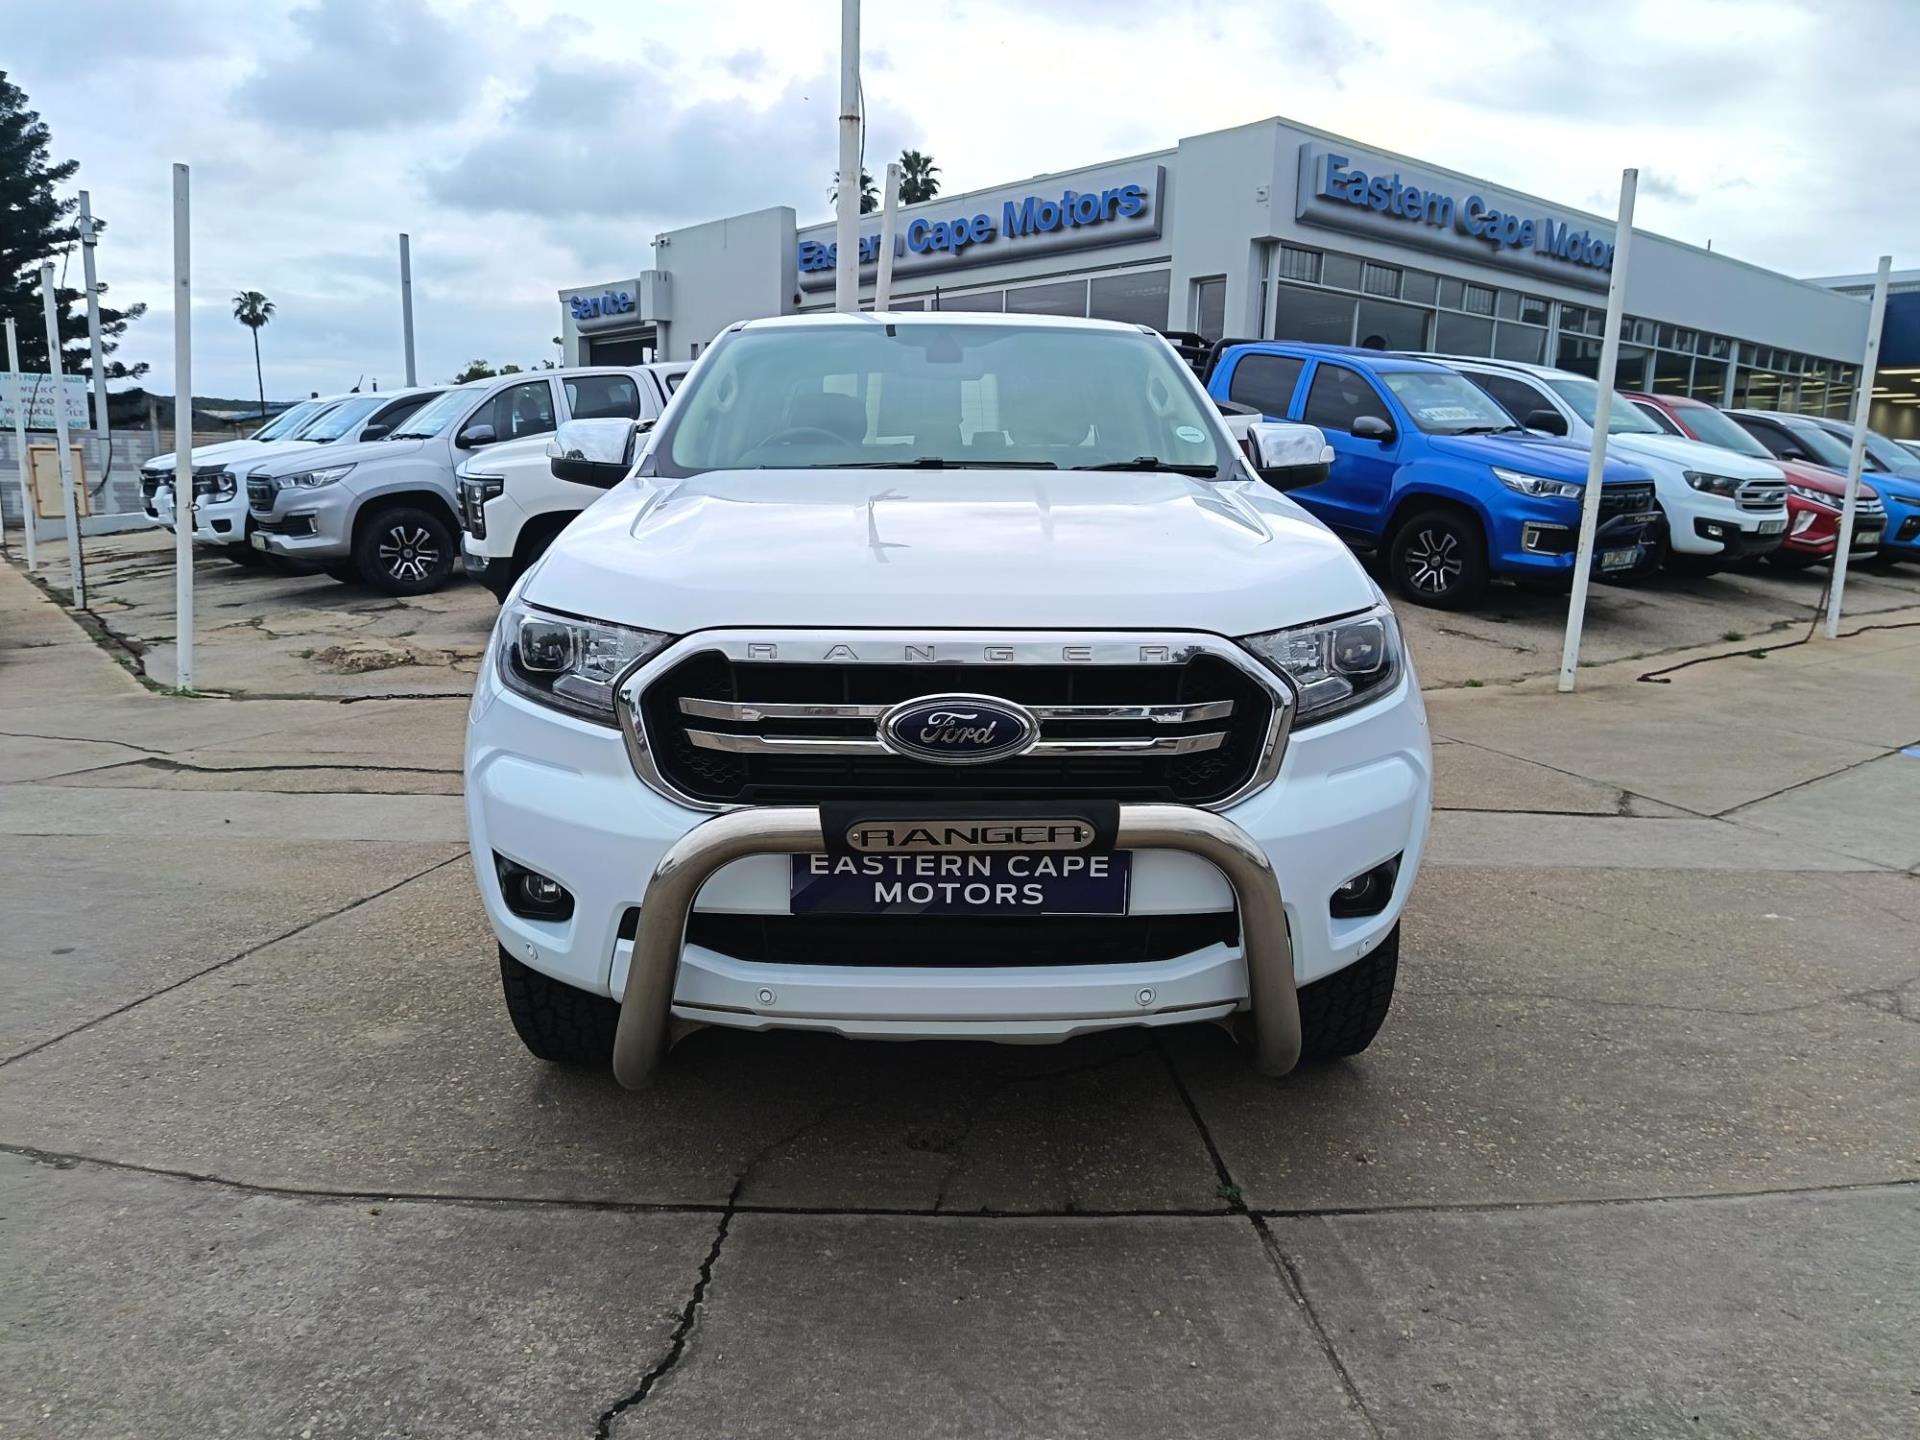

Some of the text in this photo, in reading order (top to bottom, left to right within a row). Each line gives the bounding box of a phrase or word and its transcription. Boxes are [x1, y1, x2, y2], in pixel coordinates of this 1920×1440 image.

[906, 212, 996, 257] Cape
[1002, 184, 1148, 239] Motors
[1323, 152, 1616, 269] Eastern Cape Motor
[570, 290, 634, 319] Service
[747, 642, 1170, 662] RANGER
[920, 711, 998, 744] Ford
[860, 825, 1083, 847] RANGER
[809, 854, 1110, 878] EASTERN CAPE
[873, 881, 1045, 905] MOTORS
